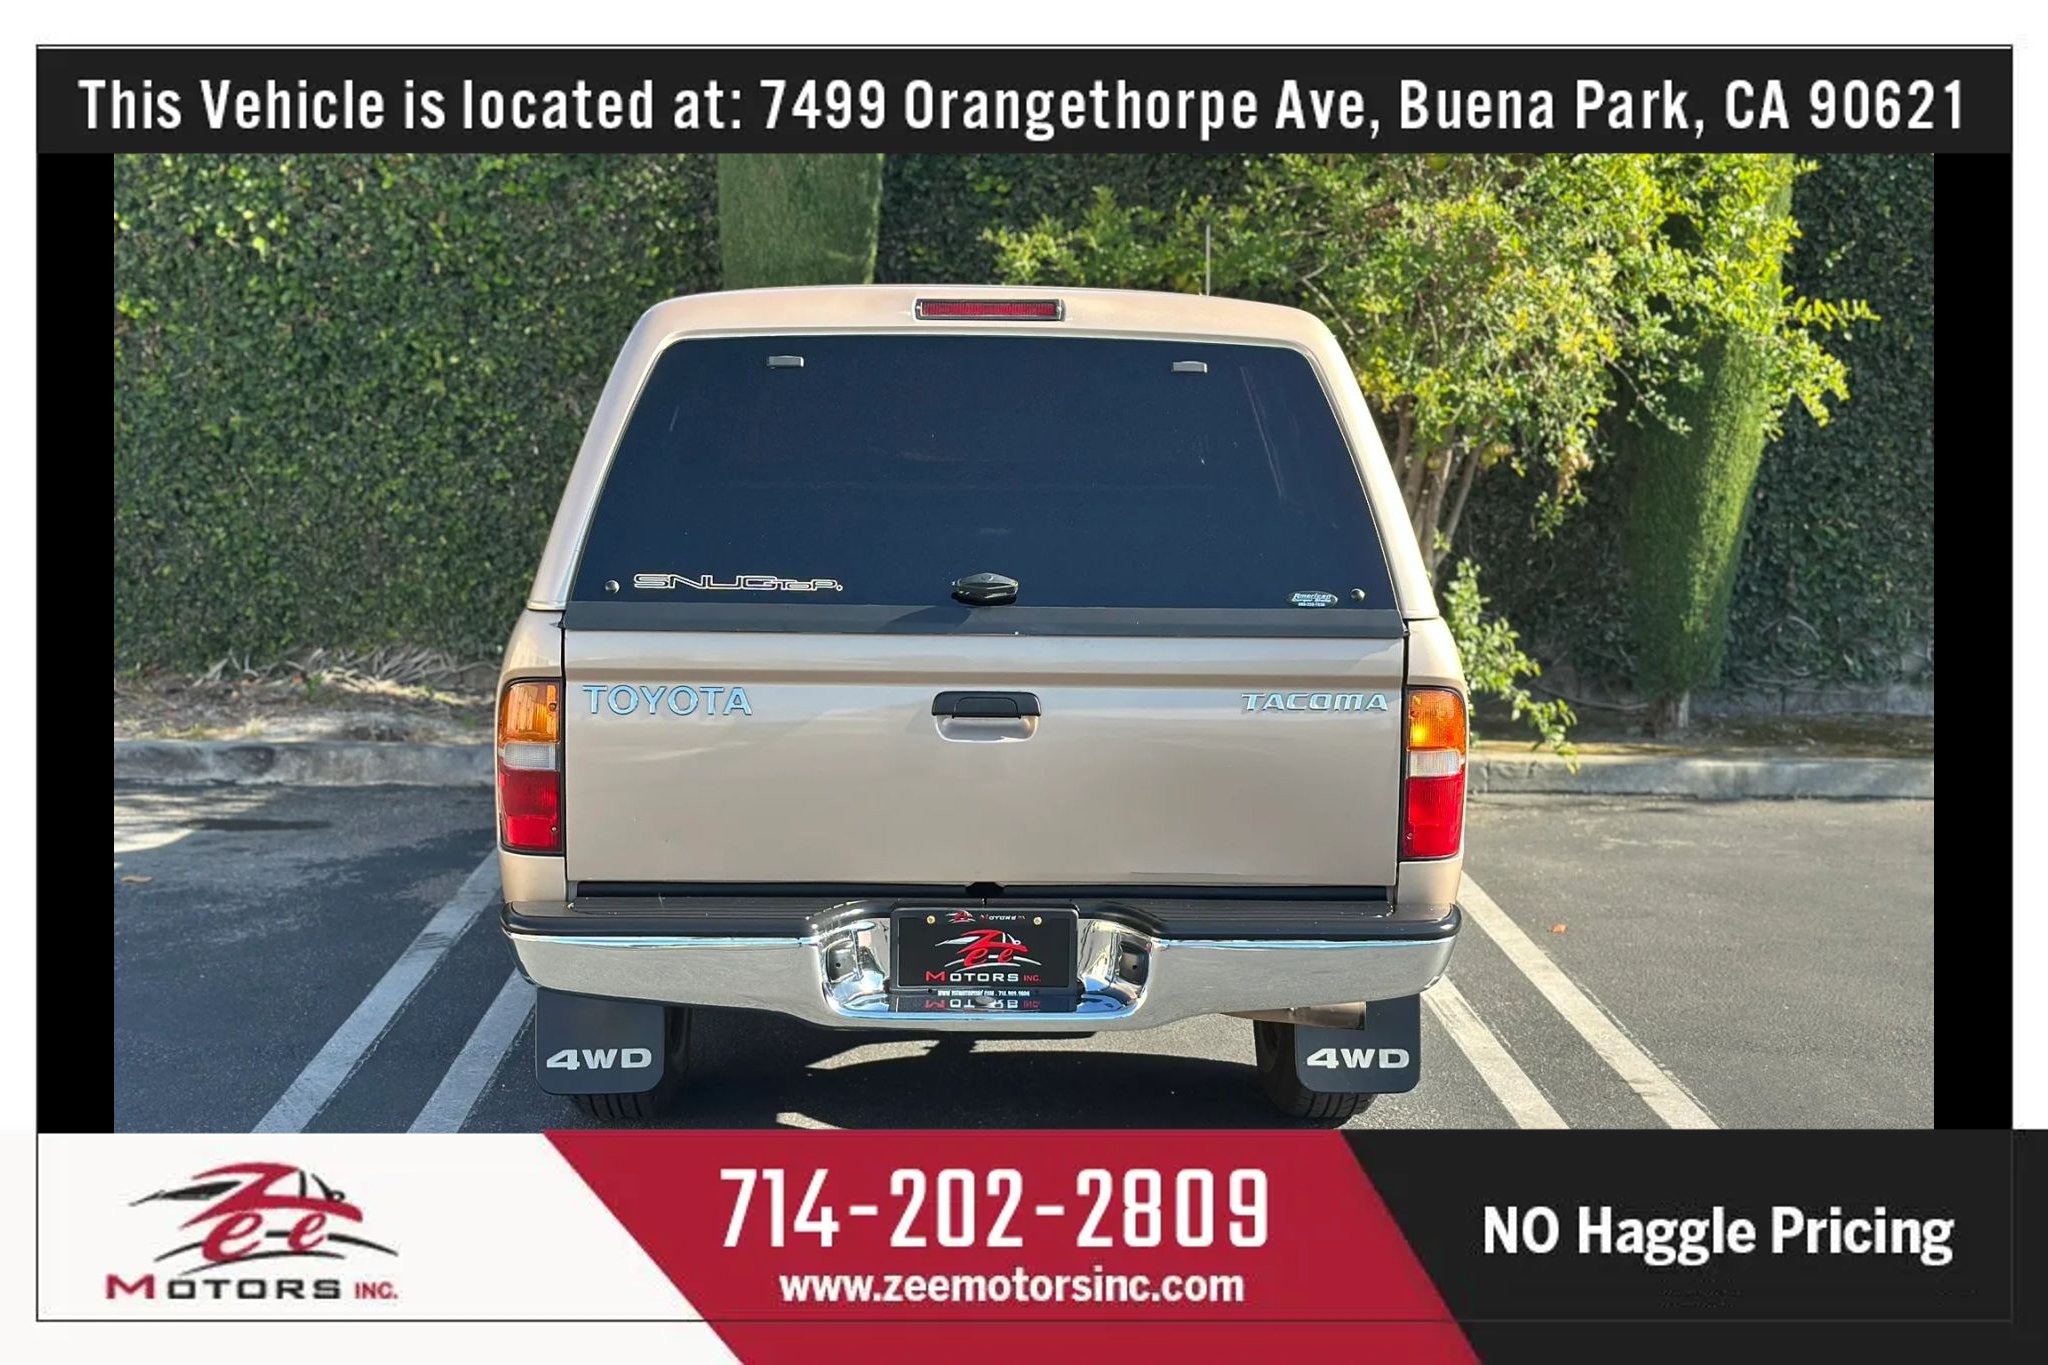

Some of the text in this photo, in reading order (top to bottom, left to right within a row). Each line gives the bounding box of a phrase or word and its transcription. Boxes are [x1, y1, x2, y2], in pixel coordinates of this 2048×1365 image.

[582, 684, 752, 716] TOYOTA
[1241, 692, 1388, 711] TACOMA
[925, 970, 1019, 982] MOTORS
[546, 1048, 652, 1070] 4WD
[1306, 1048, 1410, 1069] 4WD
